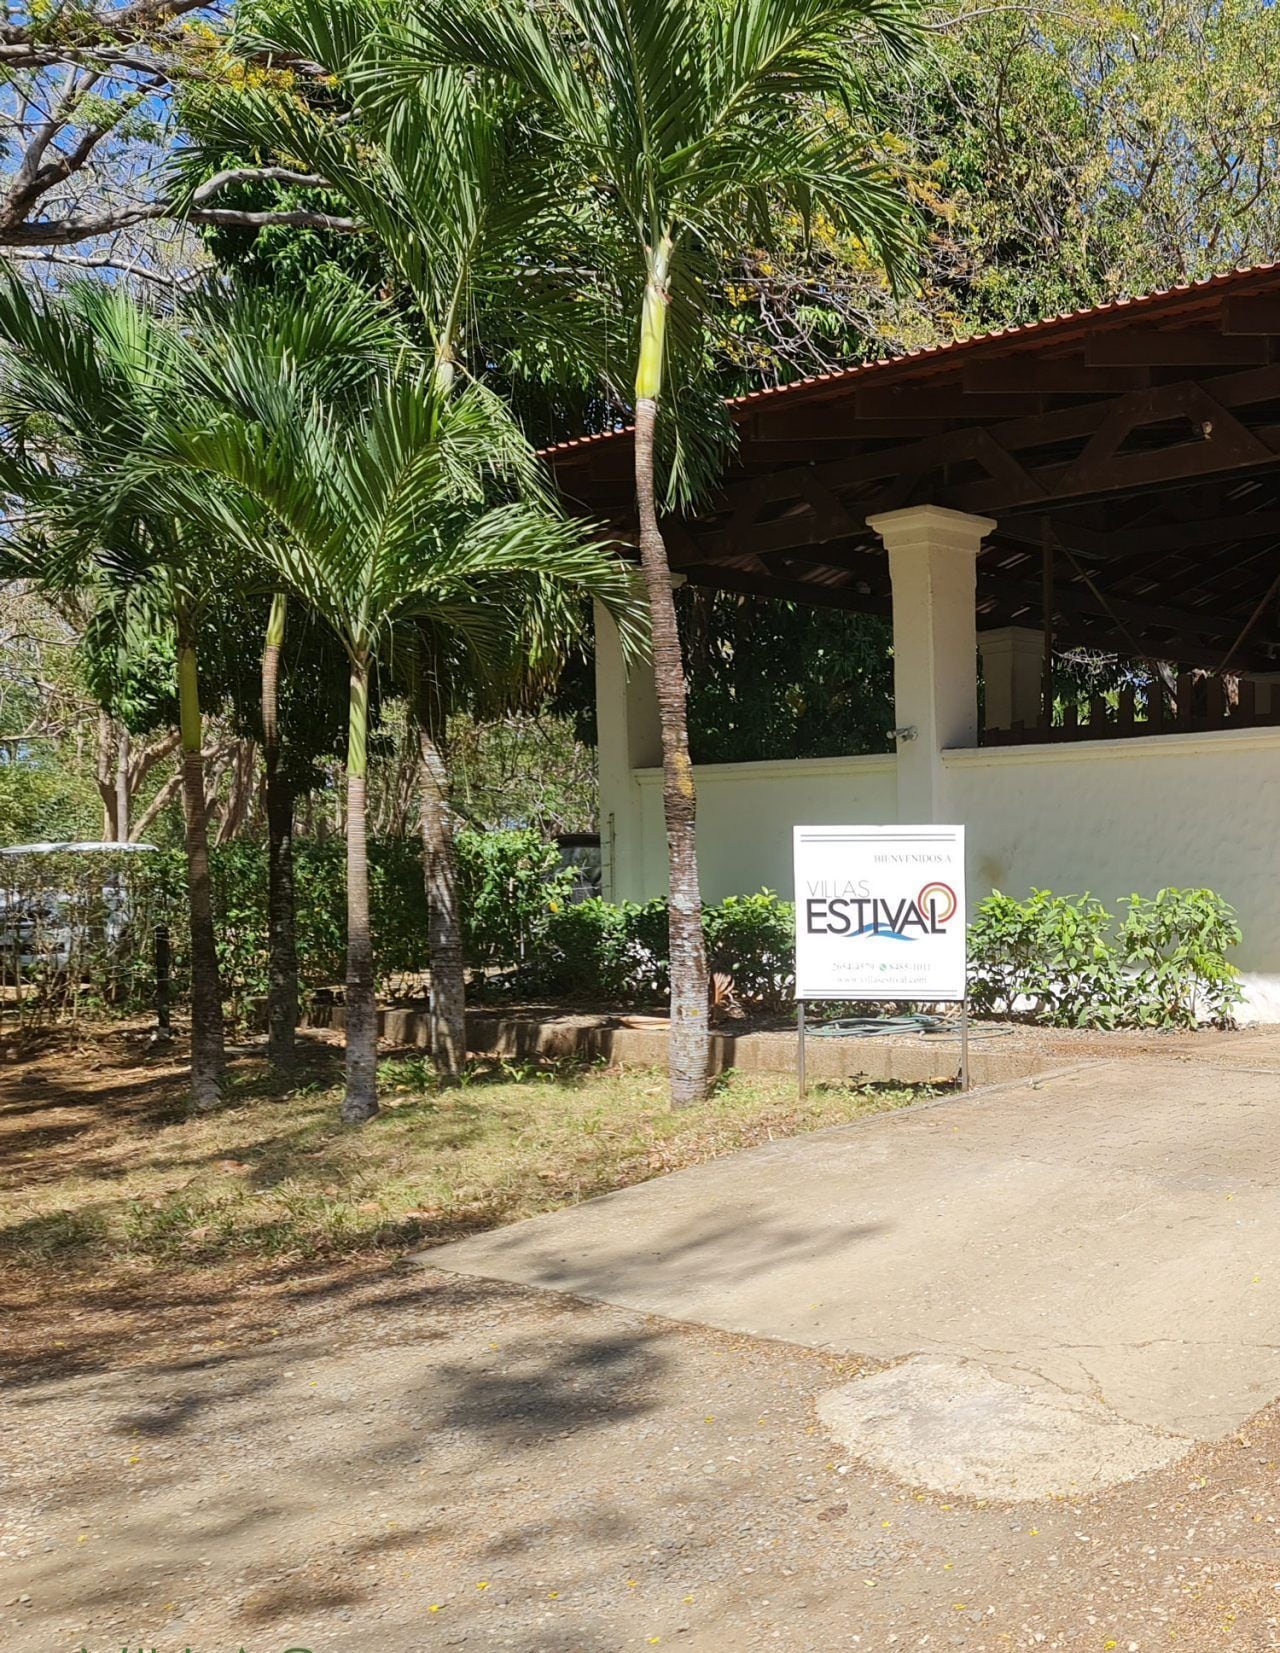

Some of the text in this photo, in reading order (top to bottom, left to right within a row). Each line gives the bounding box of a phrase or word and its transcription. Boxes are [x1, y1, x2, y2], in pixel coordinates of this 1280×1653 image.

[873, 854, 952, 864] BIENVENIDOS A
[806, 880, 870, 898] VILLAS
[806, 898, 946, 934] ESTIVAL
